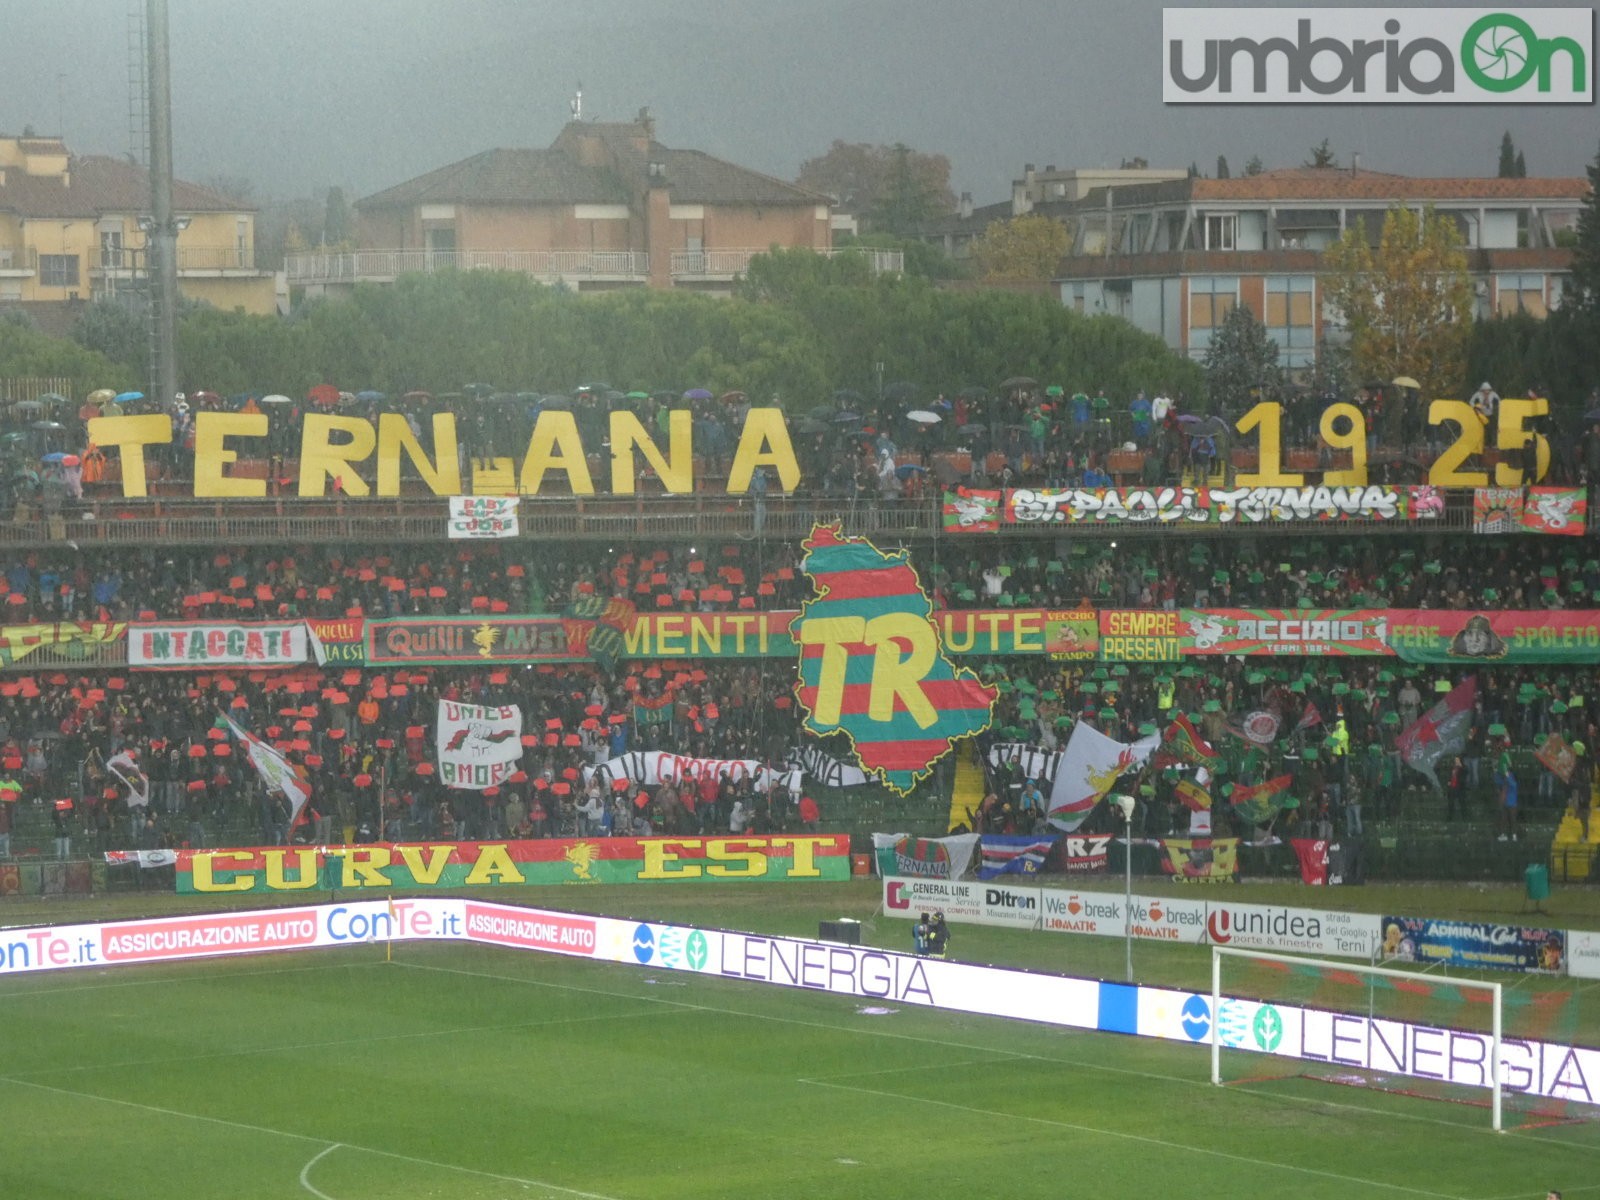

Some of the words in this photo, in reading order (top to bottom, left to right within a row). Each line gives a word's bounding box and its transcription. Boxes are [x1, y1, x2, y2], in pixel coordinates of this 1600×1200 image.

[464, 499, 507, 509] BABY
[1209, 486, 1398, 521] TERNANA
[455, 518, 512, 531] CUORE
[1047, 612, 1095, 620] VECCHIO
[1110, 612, 1177, 635] SEMPRE
[1237, 620, 1363, 640] ACCIAIO
[1513, 625, 1599, 648] SPOLETO
[143, 630, 292, 659] INTACCATI
[387, 627, 463, 656] Quilli
[1104, 638, 1180, 660] PRESENTI
[1051, 652, 1094, 661] STAMPO
[801, 612, 938, 729] TR
[1067, 836, 1111, 858] RZ
[192, 842, 526, 892] CURVA
[637, 837, 836, 880] EST
[913, 883, 949, 895] GENERAL
[951, 886, 969, 897] LINE
[986, 888, 1035, 909] Ditron
[914, 904, 945, 912] PERSONAL
[946, 906, 981, 916] COMPUTER
[956, 896, 981, 907] Service
[1046, 897, 1067, 915] We
[1084, 901, 1120, 920] break
[326, 902, 461, 941] ConTe.it
[1045, 918, 1096, 932] LIOMATIC
[1166, 907, 1203, 926] break
[1233, 909, 1321, 938] unidea
[1325, 913, 1351, 923] strada
[107, 923, 260, 955] ASSICURAZIONE
[264, 919, 314, 939] AUTO
[467, 913, 560, 943] ASSICURAZIONE
[560, 928, 594, 948] AUTO
[1325, 926, 1338, 935] del
[1428, 922, 1489, 942] ADMIRAL
[1233, 934, 1263, 946] porte
[1266, 937, 1275, 945] &
[1278, 937, 1324, 950] finestre
[1334, 938, 1365, 952] Terni
[721, 933, 934, 1004] LENERGIA
[1301, 1008, 1592, 1102] LENERGIA
